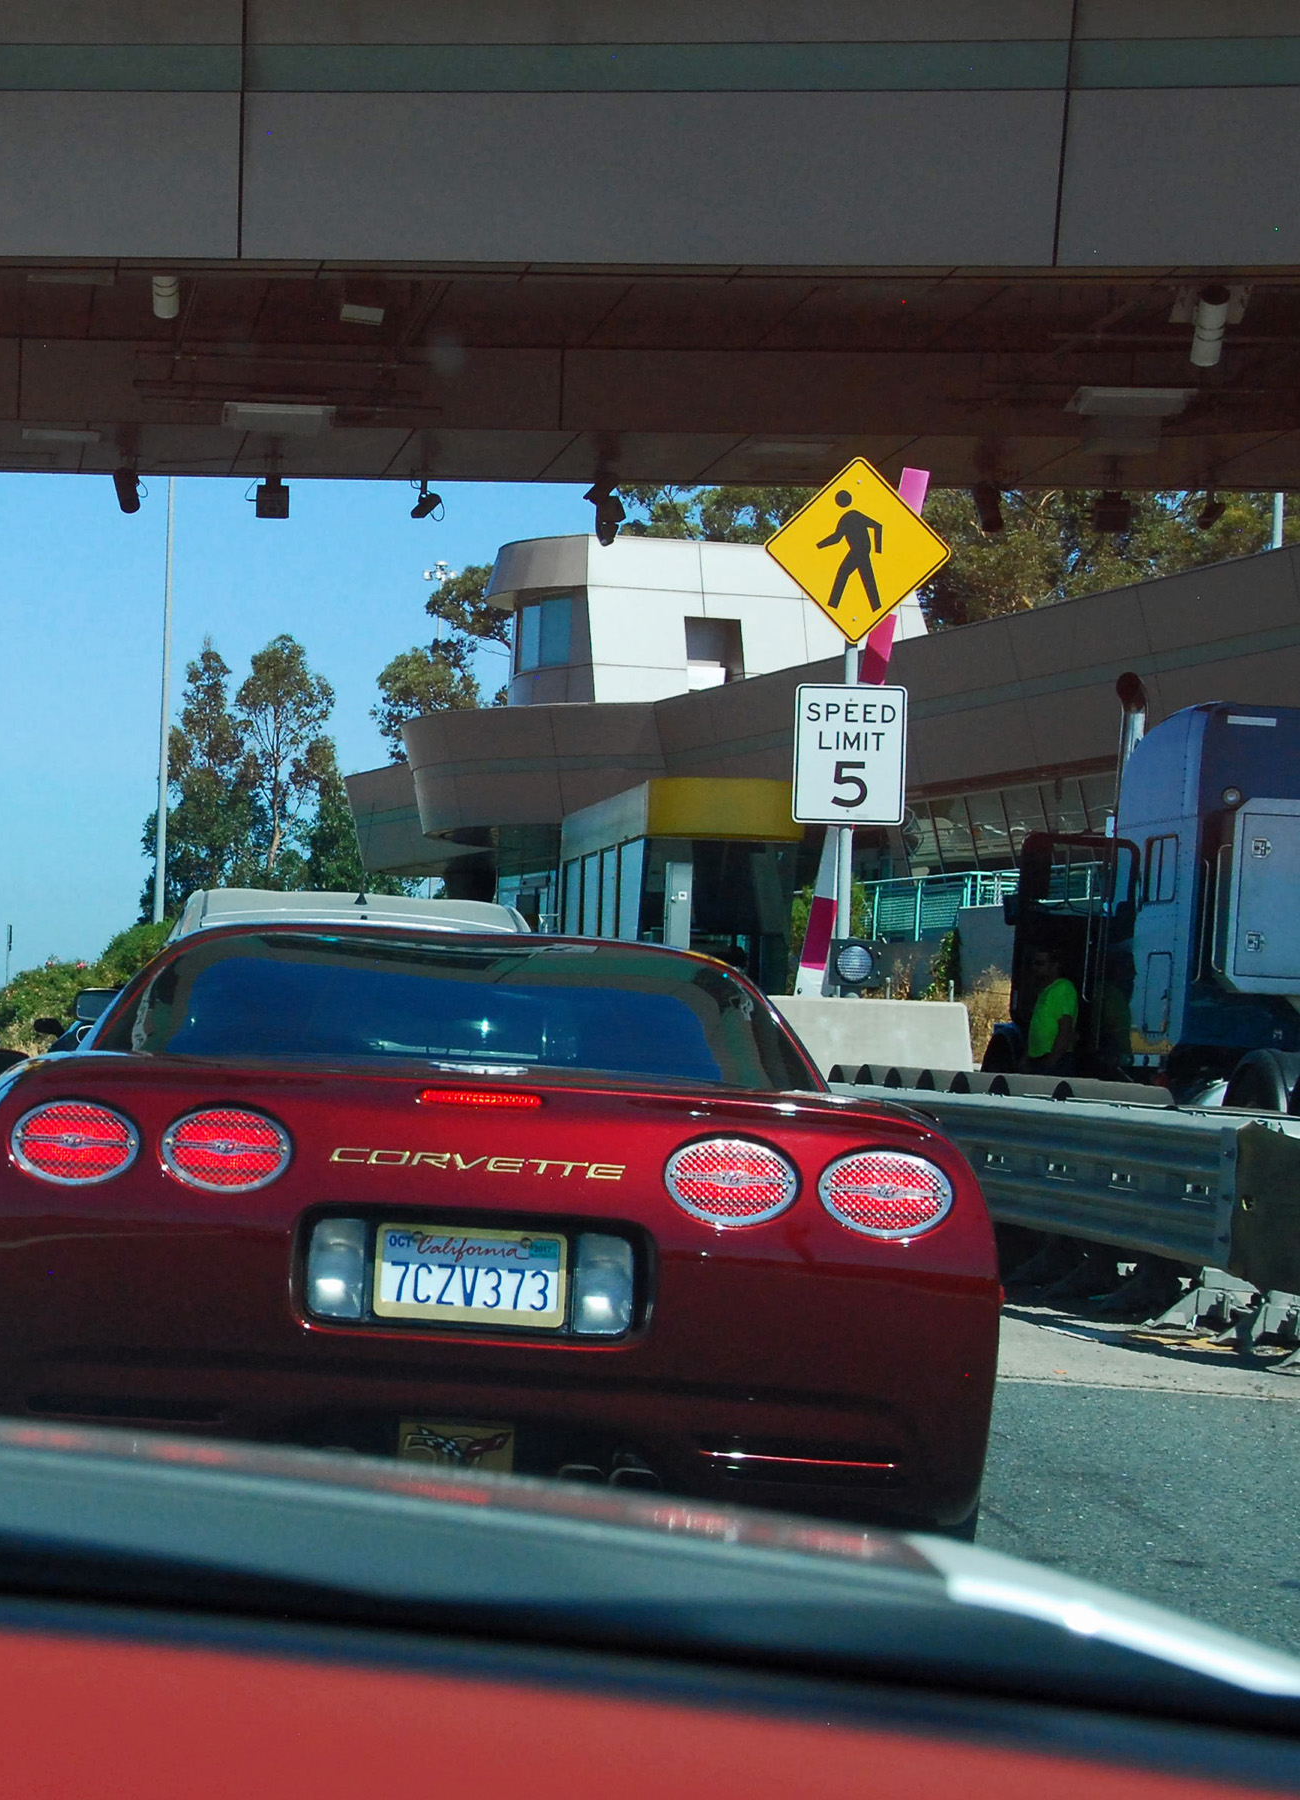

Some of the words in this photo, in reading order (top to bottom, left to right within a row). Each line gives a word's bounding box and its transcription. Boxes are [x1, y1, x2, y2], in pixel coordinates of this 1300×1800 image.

[806, 702, 896, 724] SPEED
[818, 730, 885, 751] LIMIT
[830, 761, 868, 808] 5
[330, 1147, 626, 1180] CORVETTE
[389, 1234, 411, 1248] OCT
[416, 1234, 530, 1263] California
[391, 1260, 549, 1312] 7CZV373
